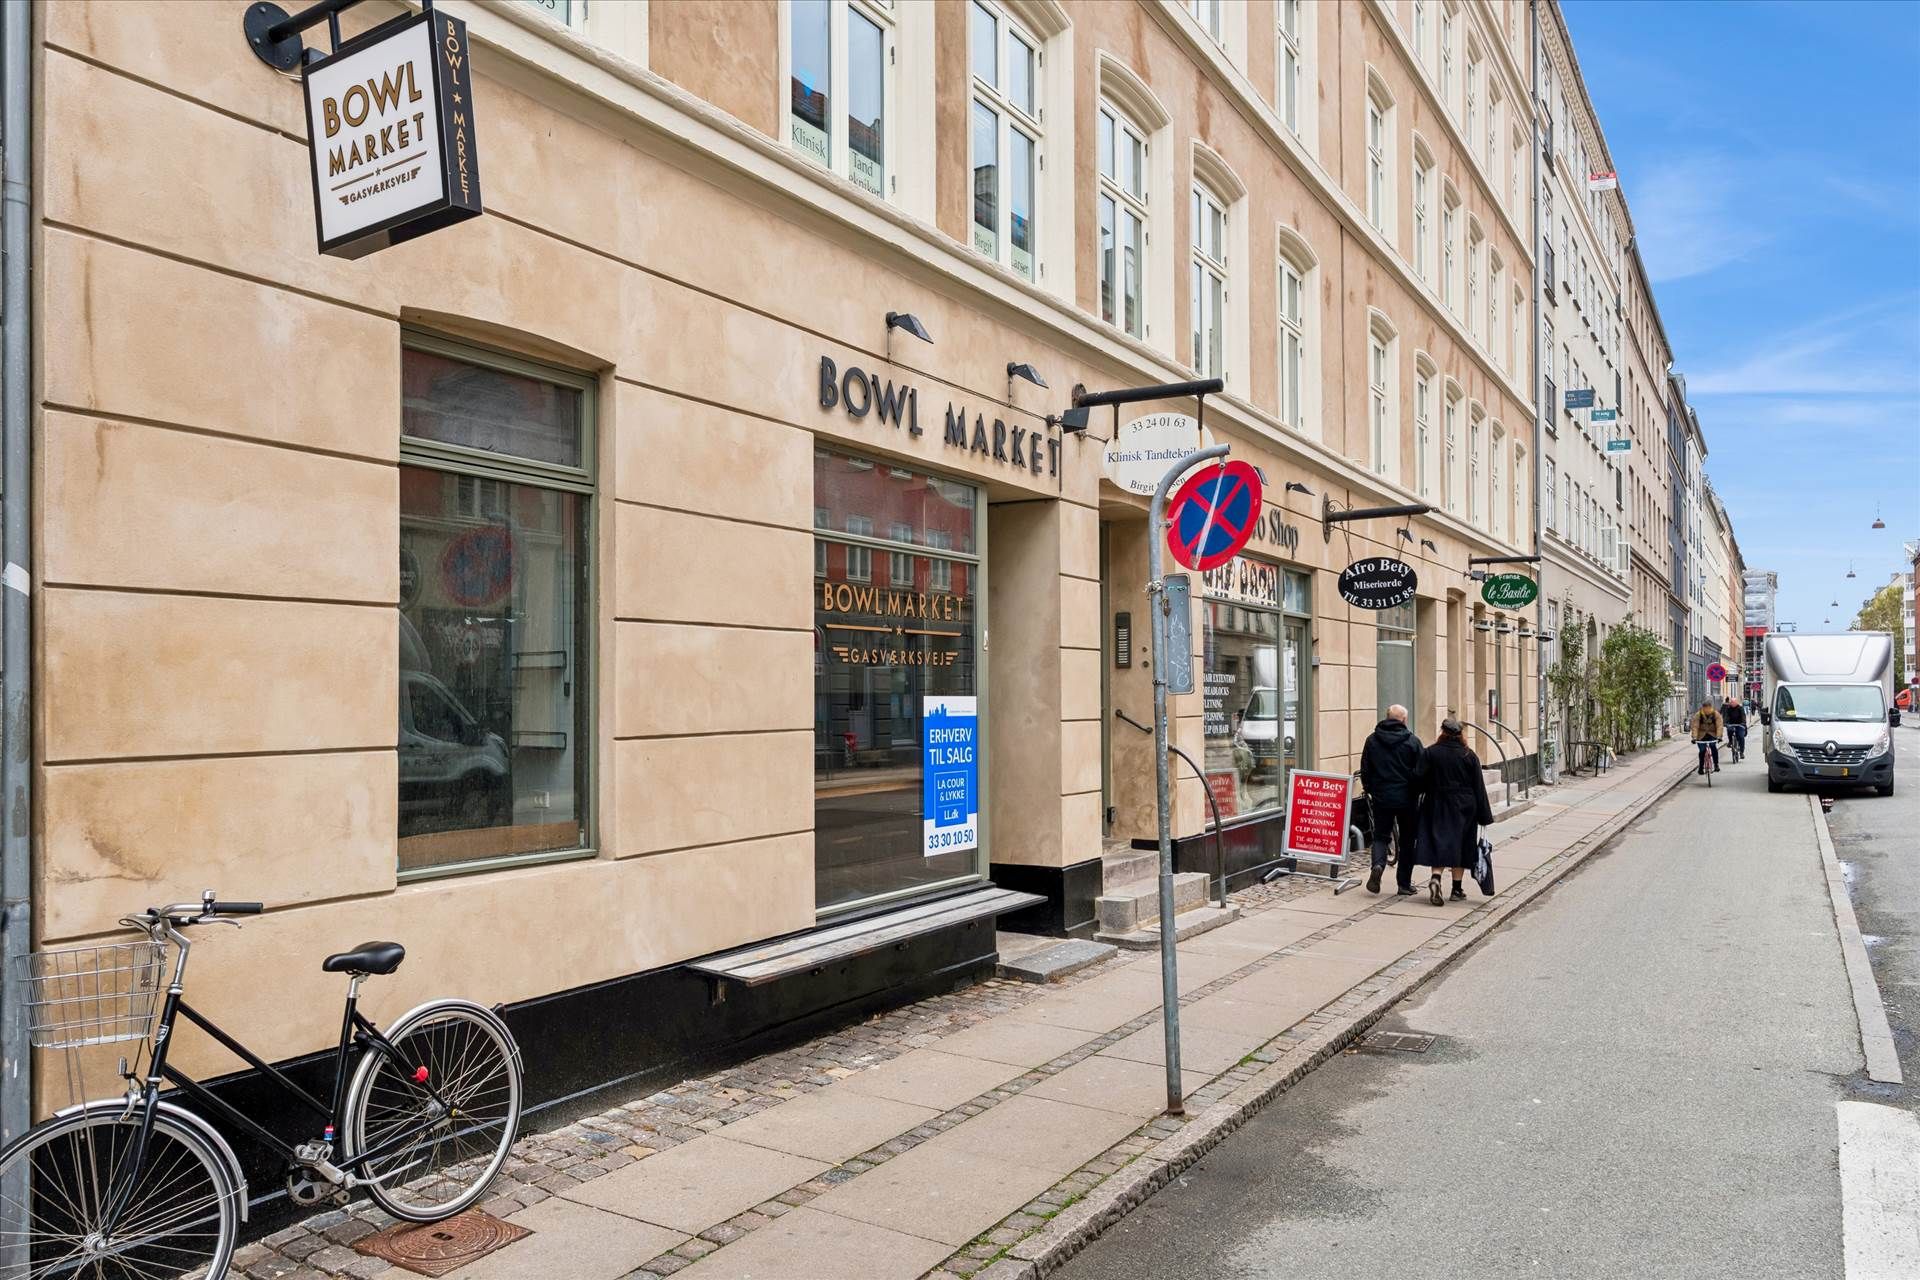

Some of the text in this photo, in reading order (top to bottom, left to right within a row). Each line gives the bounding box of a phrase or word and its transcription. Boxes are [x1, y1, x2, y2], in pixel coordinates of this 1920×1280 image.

[322, 61, 422, 138] BOWL
[445, 20, 469, 204] BOWL MARKET
[328, 112, 424, 177] MARKET
[792, 124, 826, 159] Klinisk
[852, 151, 873, 178] Tand
[350, 172, 410, 204] GASVÆRKSVEJ
[1011, 258, 1029, 274] arsen
[820, 355, 1060, 478] BOWL MARKET
[1132, 416, 1186, 434] 33 24 01 63
[1107, 450, 1142, 463] Klinisk
[1130, 480, 1155, 494] Birgit
[1269, 508, 1298, 560] Shop
[1344, 559, 1412, 580] Afro Bety
[1354, 578, 1402, 590] Misericorde
[1487, 584, 1496, 600] le
[1360, 598, 1373, 608] 33
[1390, 594, 1402, 606] 12
[850, 648, 944, 666] GASVÆRKSVEJ
[929, 728, 972, 744] ERHVERV
[928, 746, 972, 766] TIL SALG
[938, 778, 965, 790] LA COUR
[1297, 778, 1344, 794] Afro Bety
[939, 790, 965, 802] & LYKKE
[1297, 798, 1342, 810] DREADLOCKS
[944, 808, 959, 820] LL.dk
[1302, 808, 1335, 818] FLETNING
[928, 829, 974, 849] 33 30 10 50
[1295, 826, 1310, 834] CLIP
[1322, 828, 1339, 836] HAIR
